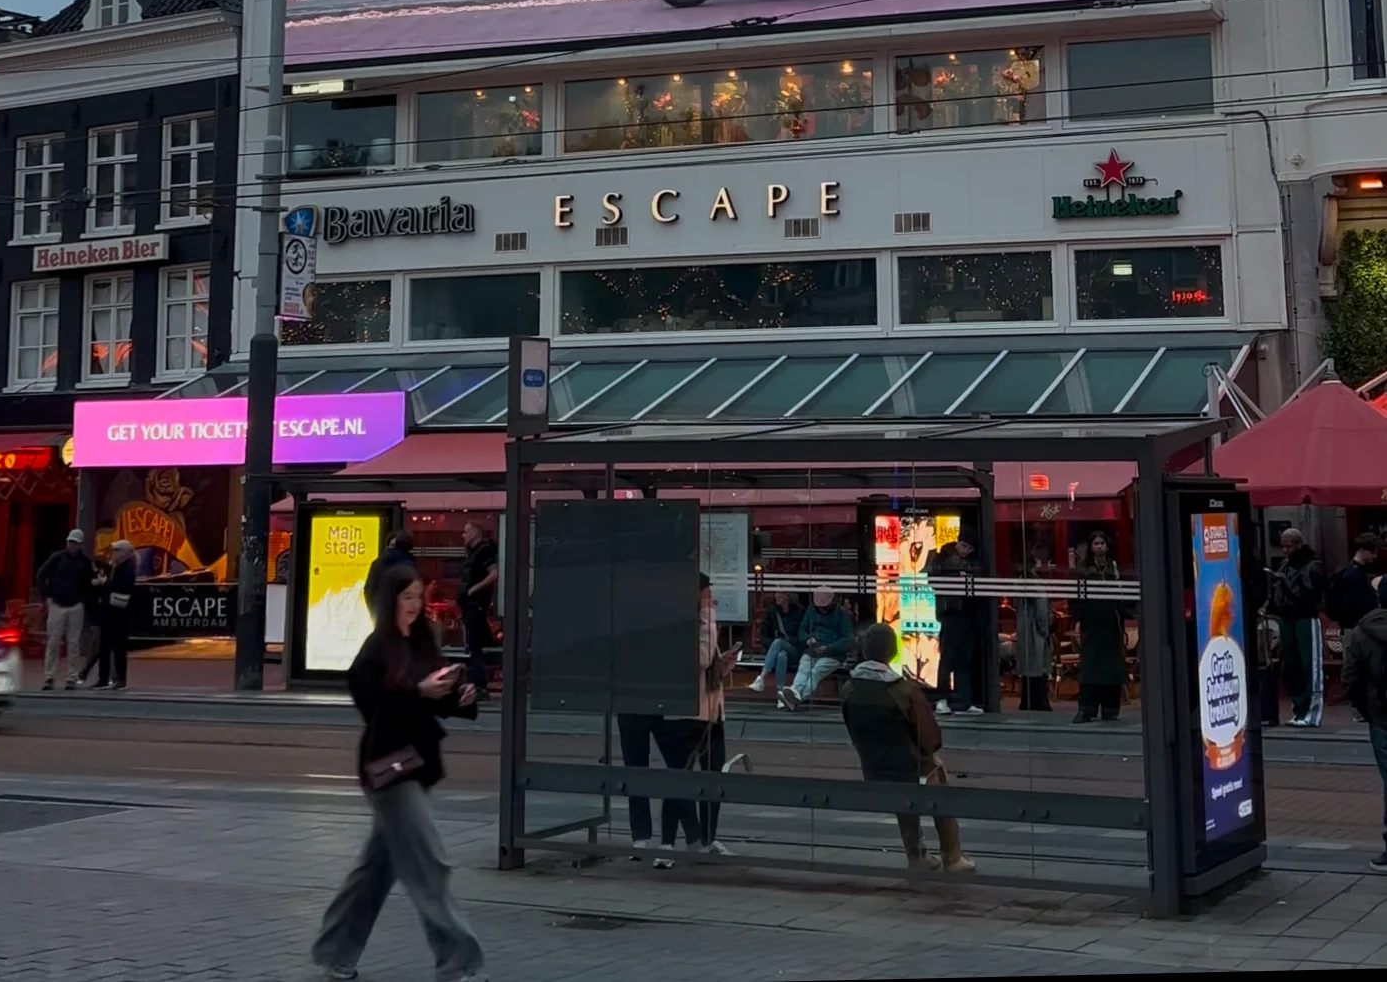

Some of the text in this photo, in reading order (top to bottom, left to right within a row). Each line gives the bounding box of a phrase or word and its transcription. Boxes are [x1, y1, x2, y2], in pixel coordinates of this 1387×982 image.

[555, 181, 841, 228] ESCAPE
[1051, 193, 1180, 219] Heineken
[323, 195, 475, 245] Bavaria
[36, 239, 160, 269] Heineken Bier
[107, 424, 137, 441] GET
[141, 423, 185, 440] YOUR
[278, 418, 366, 437] ESCAPE.NL
[127, 506, 172, 538] ESCAPE
[327, 525, 362, 540] Main
[324, 541, 366, 559] stage
[152, 597, 227, 617] ESCAPE
[152, 618, 228, 627] AMSTERDAM
